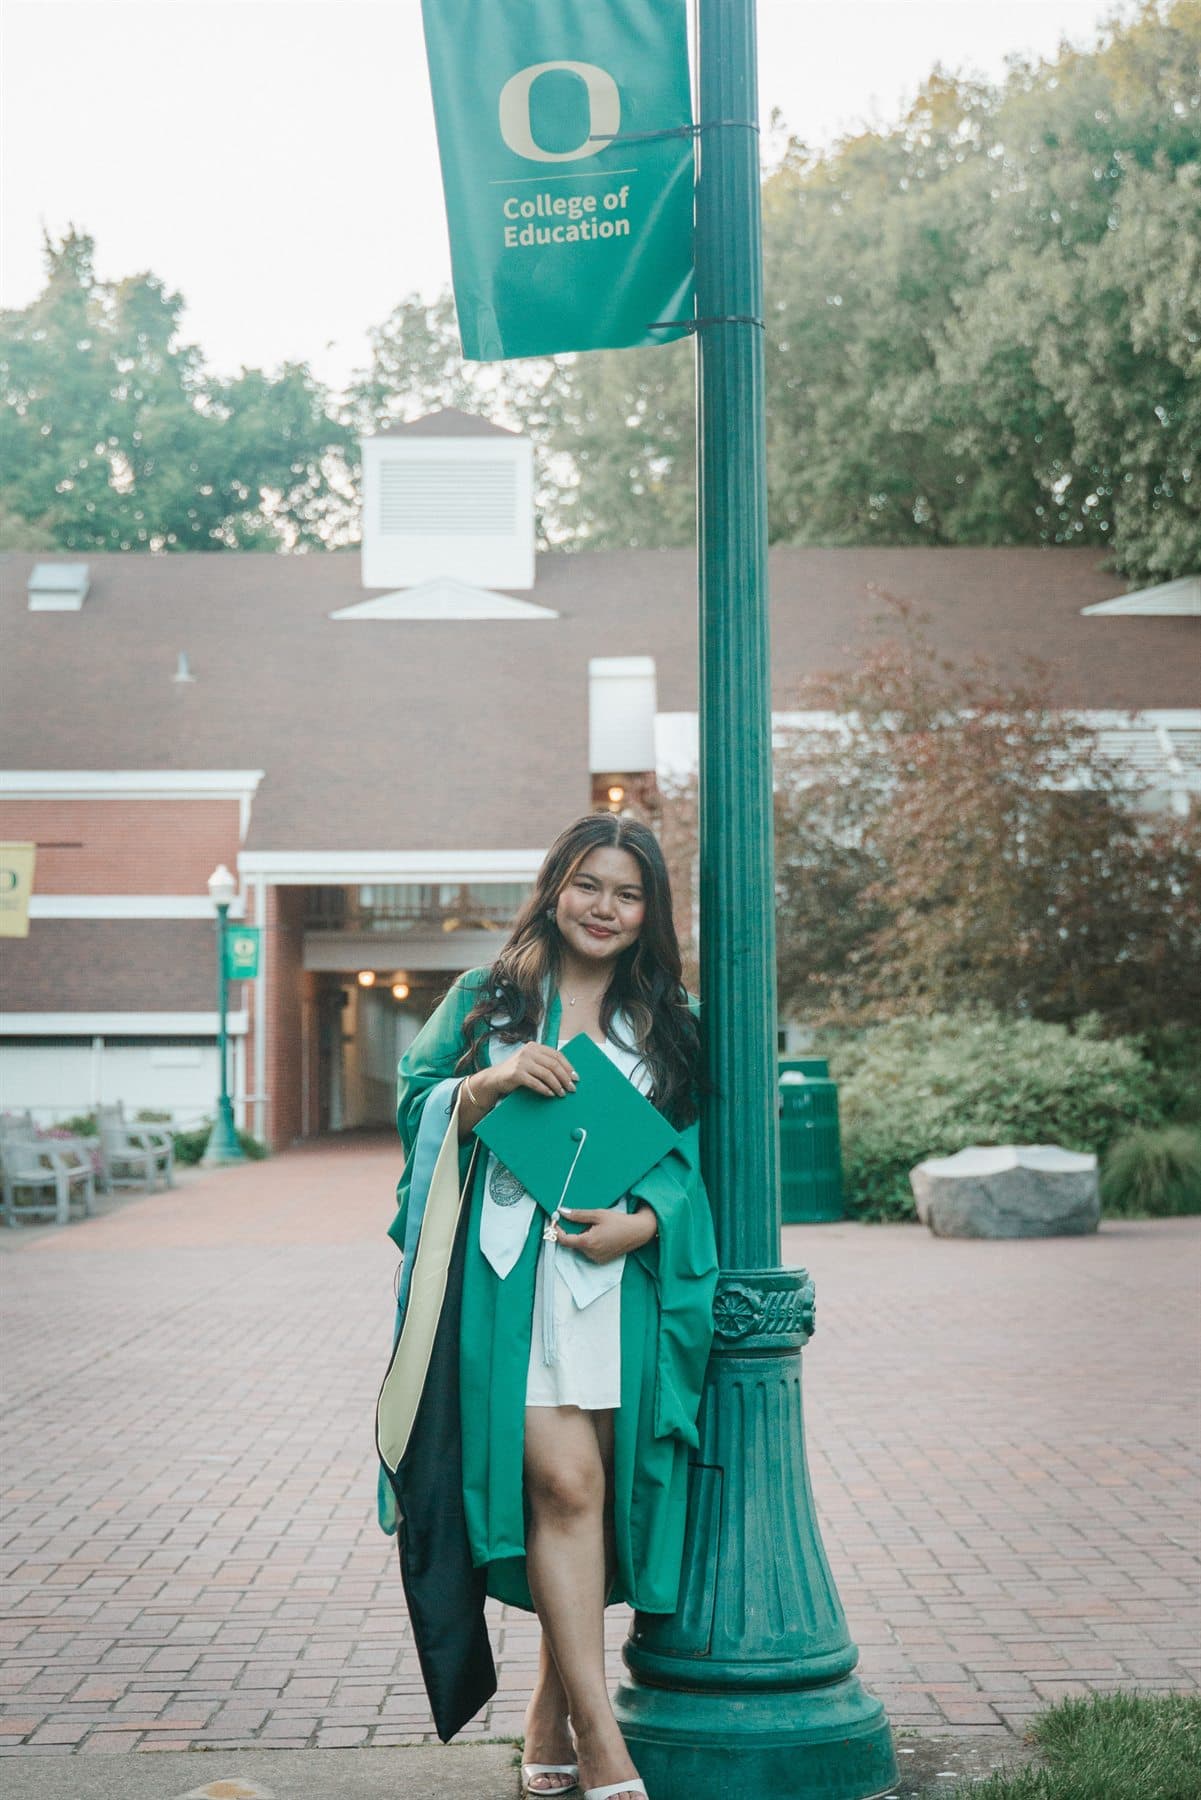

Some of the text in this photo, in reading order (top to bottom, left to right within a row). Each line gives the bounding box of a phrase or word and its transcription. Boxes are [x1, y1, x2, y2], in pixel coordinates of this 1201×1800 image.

[499, 60, 621, 163] O
[503, 186, 630, 219] College of
[504, 218, 630, 247] Education
